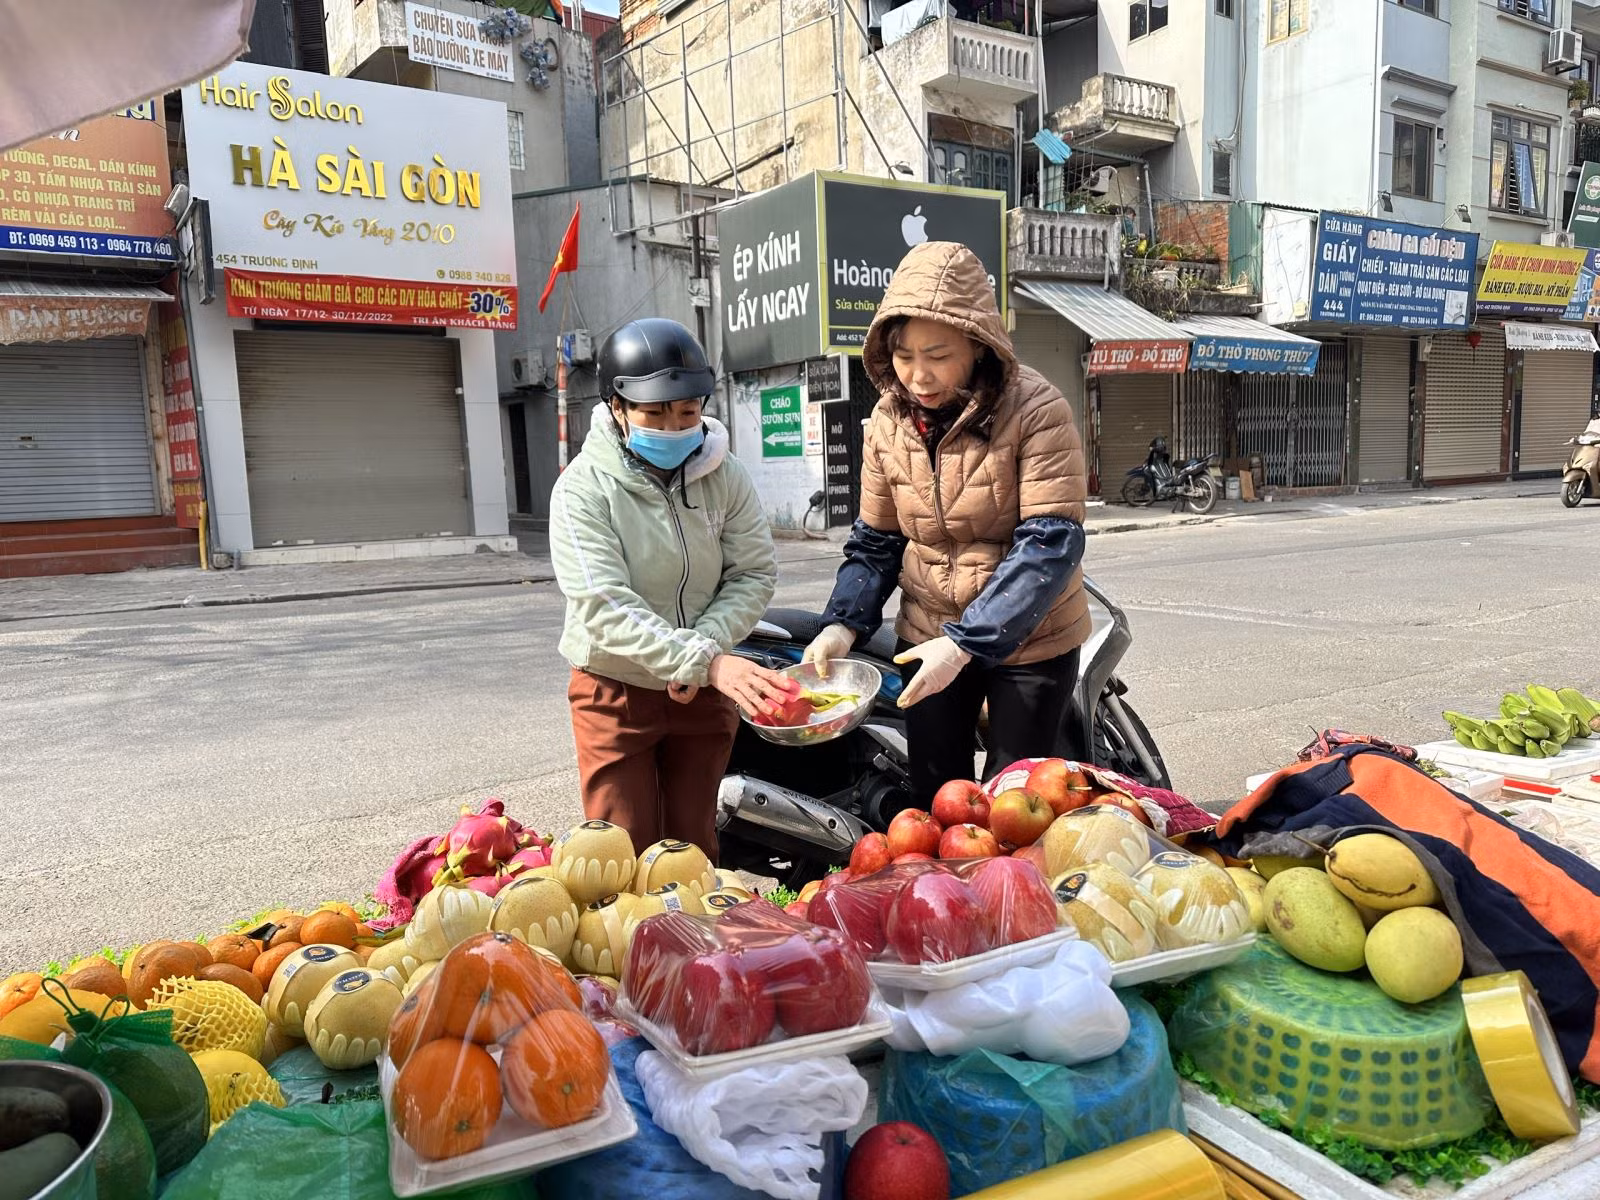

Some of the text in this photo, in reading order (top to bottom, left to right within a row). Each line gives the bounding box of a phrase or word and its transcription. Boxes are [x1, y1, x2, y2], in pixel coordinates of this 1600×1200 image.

[413, 10, 454, 36] CHUYÊN
[456, 16, 477, 42] SỬA
[412, 30, 434, 57] BẢO
[436, 39, 471, 65] DƯỠNG
[472, 47, 486, 68] XE
[487, 50, 509, 73] MÁY
[201, 74, 364, 125] Hair Salon
[53, 154, 96, 172] DECAL,
[99, 156, 125, 173] DÁN
[128, 161, 157, 178] KÍNH
[230, 135, 481, 209] HÀ SÀI GÒN
[38, 170, 66, 186] TẤM
[70, 176, 105, 193] NHỰA
[107, 176, 135, 194] TRẢI
[137, 180, 162, 197] SÀN
[13, 184, 31, 203] CỎ
[34, 190, 70, 208] NHỰA
[73, 194, 114, 212] TRANG
[117, 197, 136, 213] TRÍ
[2, 205, 31, 222] RÈM
[35, 206, 56, 226] VẢI
[60, 210, 85, 226] CÁC
[263, 208, 298, 239] Cây
[401, 220, 456, 245] 2010
[1325, 217, 1363, 235] CỬA HÀNG
[9, 230, 27, 245] ĐT:
[29, 232, 55, 248] 0969
[58, 235, 77, 249] 459
[79, 237, 99, 250] 113
[107, 238, 132, 253] 0964
[134, 240, 152, 255] 778
[154, 242, 173, 256] 460
[1322, 239, 1357, 264] GIẤY
[1366, 228, 1466, 262] CHĂN GA GỐI ĐỆM
[216, 253, 319, 271] 454 TRƯƠNG ĐỊNH
[732, 230, 801, 283] ÉP KÍNH
[833, 258, 893, 292] Hoàng
[1318, 268, 1337, 293] DÁN
[1361, 256, 1384, 274] CHIẾU
[1389, 258, 1409, 278] THẢM
[1410, 260, 1426, 279] TRẢI
[1426, 264, 1440, 281] SÀN
[1440, 265, 1454, 282] CÁC
[1454, 269, 1470, 286] LOẠI
[230, 277, 257, 298] KHAI
[260, 280, 302, 301] TRƯƠNG
[304, 278, 332, 303] GIẢM
[334, 281, 352, 304] GIÁ
[355, 286, 375, 304] CHO
[377, 284, 398, 305] CÁC
[418, 287, 437, 309] HÓA
[439, 286, 464, 310] CHẤT
[469, 291, 510, 316] 30%
[1423, 287, 1432, 299] GIA
[1484, 278, 1503, 294] BÁNH
[1501, 282, 1516, 297] KẸO
[1517, 282, 1535, 299] RƯỢU
[1532, 283, 1544, 296] BIA
[243, 305, 257, 316] TỪ
[261, 305, 290, 318] NGÀY
[331, 310, 393, 322] 30/12/2022
[727, 282, 810, 333] LẤY NGAY
[835, 298, 853, 310] Sửa
[853, 299, 875, 311] chữa
[1323, 300, 1344, 311] 444
[413, 316, 429, 325] TRI
[450, 317, 485, 328] KHÁCH
[488, 319, 516, 330] HÀNG
[1093, 344, 1109, 364] TỦ
[1110, 345, 1135, 364] THỜ
[1141, 342, 1159, 363] ĐỒ
[1160, 344, 1185, 363] THỜ
[1196, 339, 1216, 358] ĐỒ
[1217, 343, 1243, 360] THỜ
[1244, 347, 1281, 362] PHONG
[762, 412, 783, 425] SƯỜN
[831, 423, 844, 435] MỞ
[828, 443, 848, 455] KHÓA
[828, 485, 850, 495] IPHONE
[831, 504, 848, 515] IPAD
